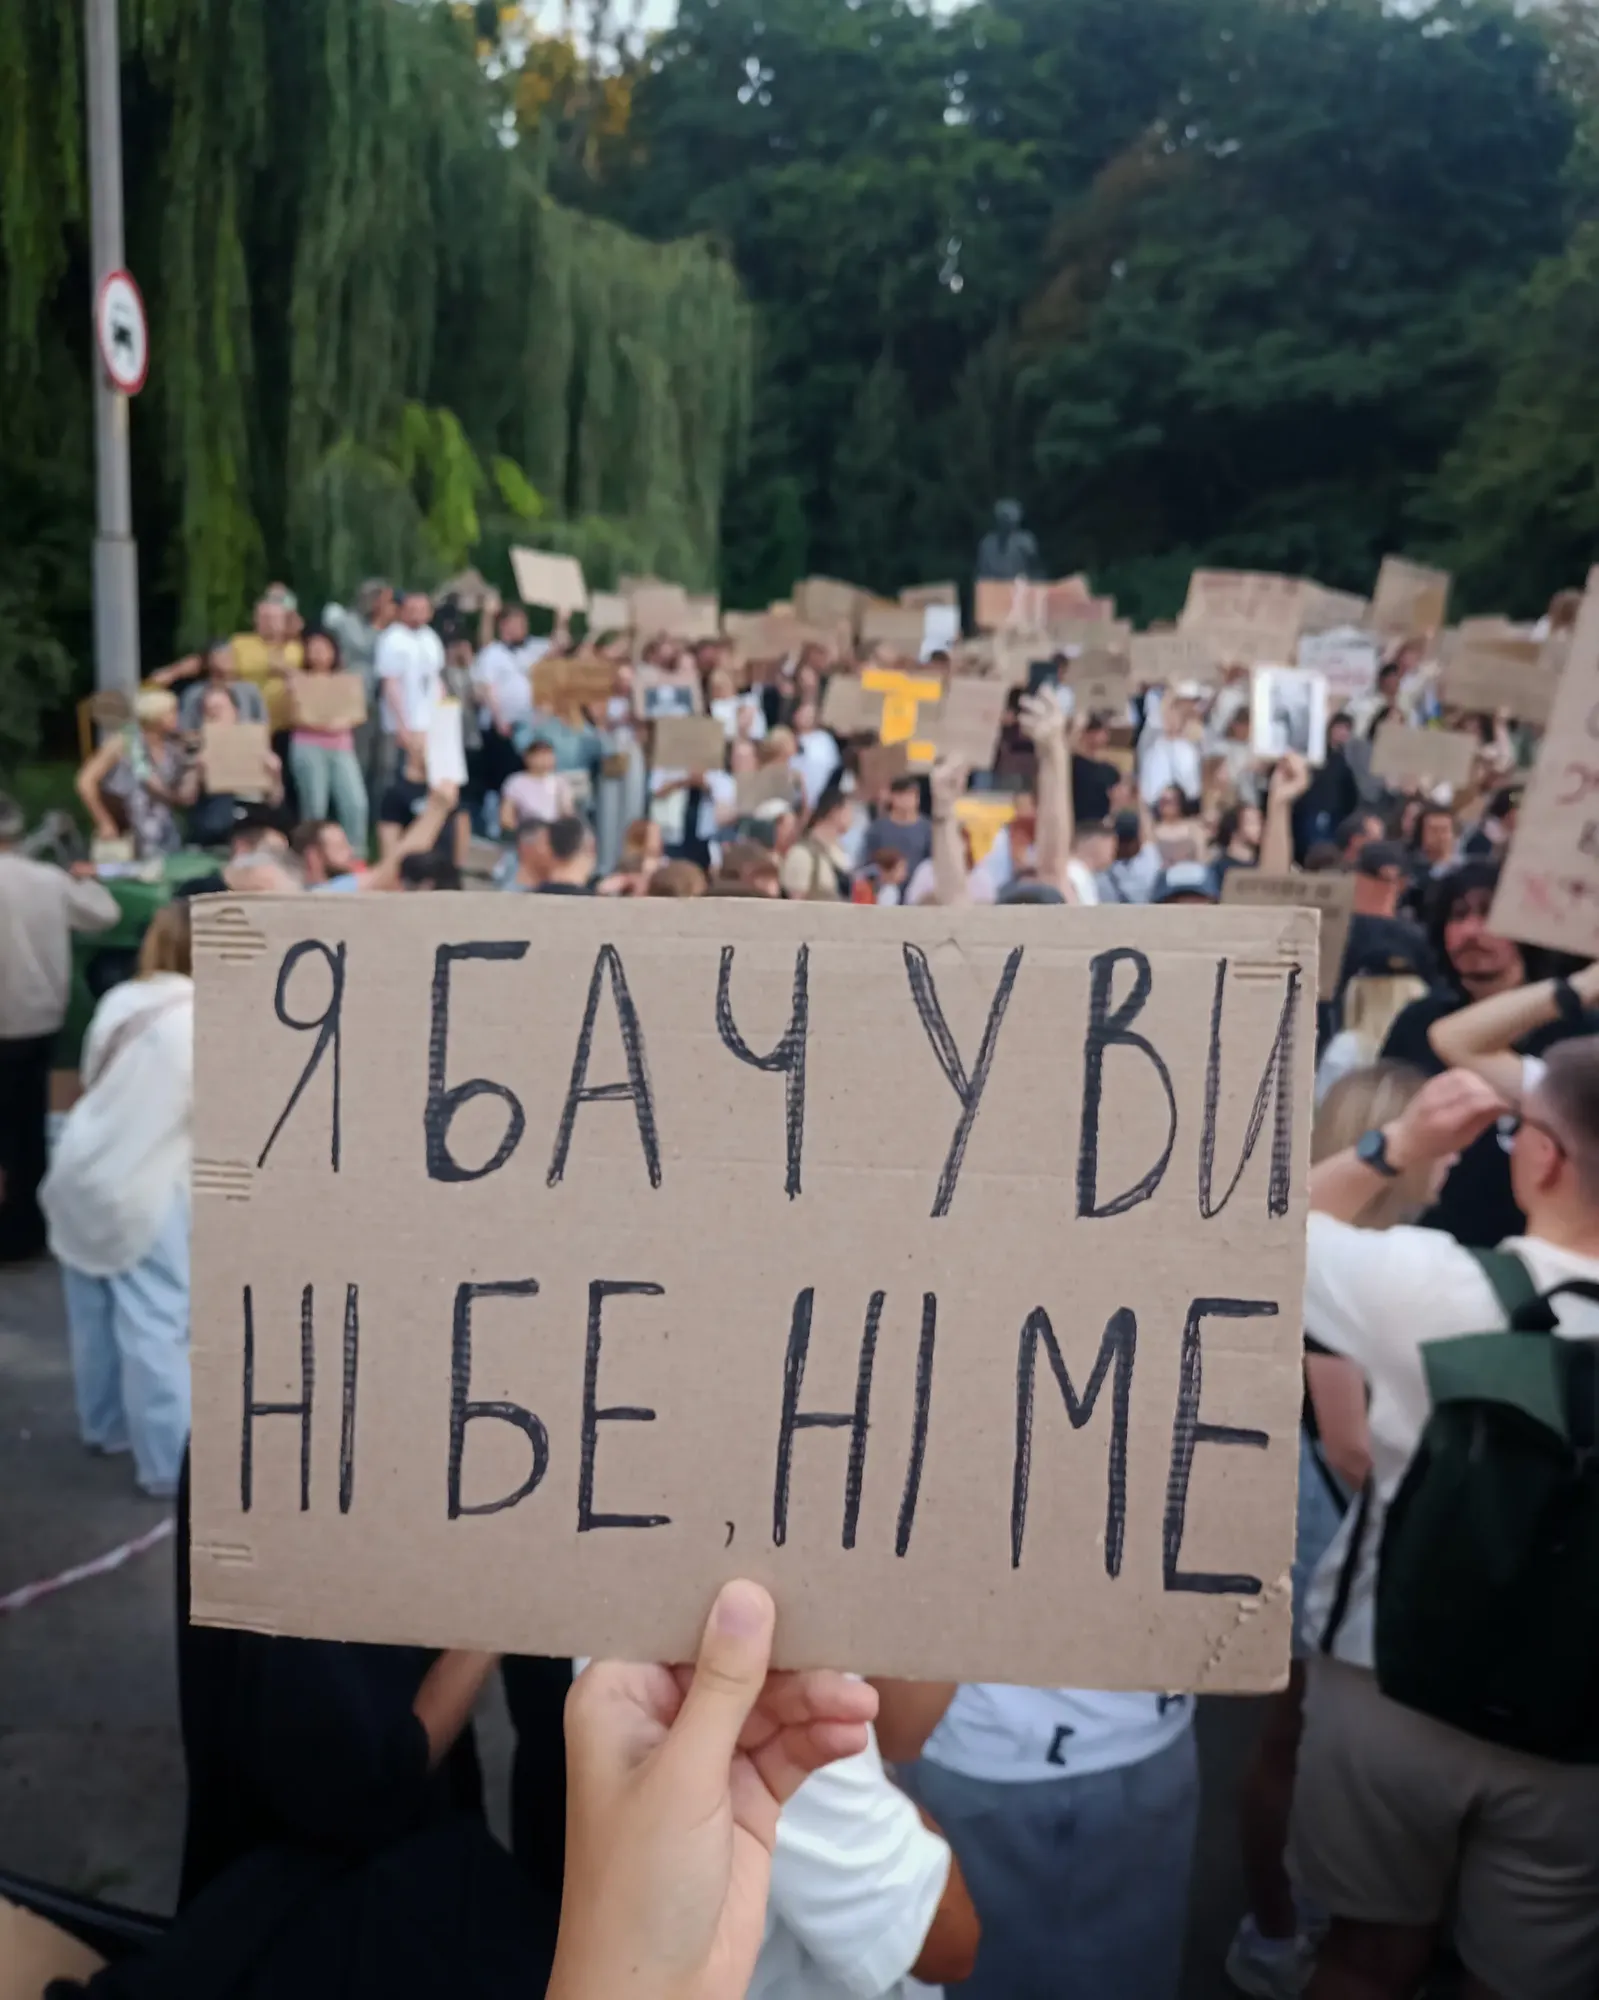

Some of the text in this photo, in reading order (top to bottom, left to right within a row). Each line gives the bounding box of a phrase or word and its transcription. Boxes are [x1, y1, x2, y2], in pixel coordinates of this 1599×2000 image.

[257, 939, 1302, 1220] Я БАЧУ ВИ
[239, 1283, 359, 1515] НІ
[772, 1287, 937, 1558] НІ
[1011, 1297, 1280, 1597] МЕ
